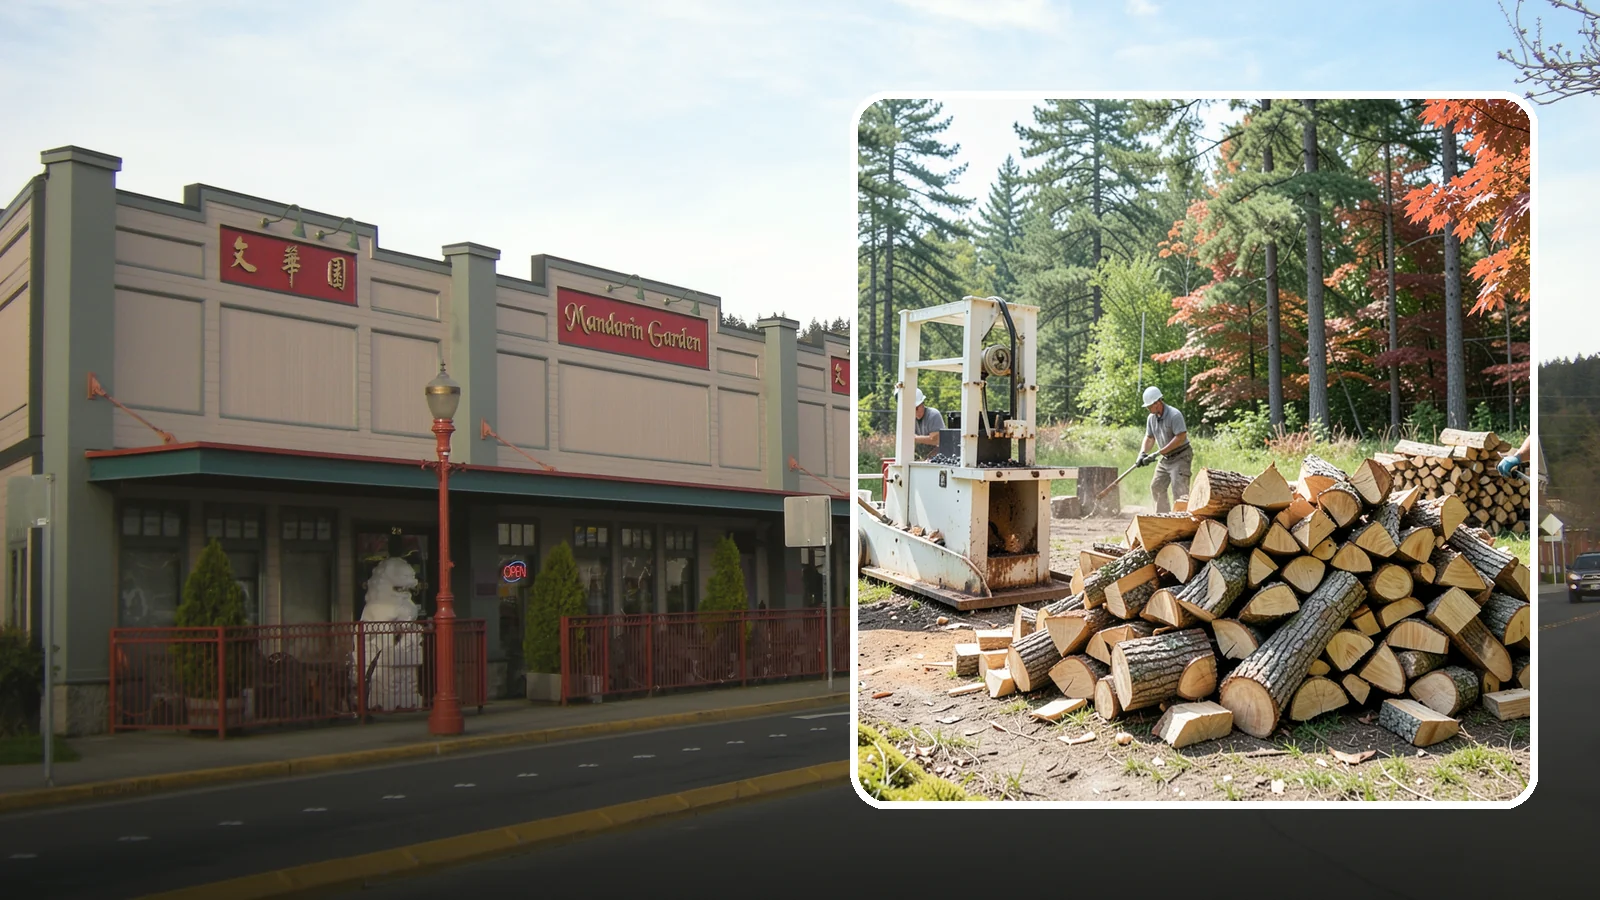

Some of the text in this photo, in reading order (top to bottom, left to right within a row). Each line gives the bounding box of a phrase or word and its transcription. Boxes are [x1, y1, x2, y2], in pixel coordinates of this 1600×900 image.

[230, 236, 346, 291] 文華園
[564, 302, 701, 352] Mandarin Garden
[503, 565, 527, 578] OPEN
